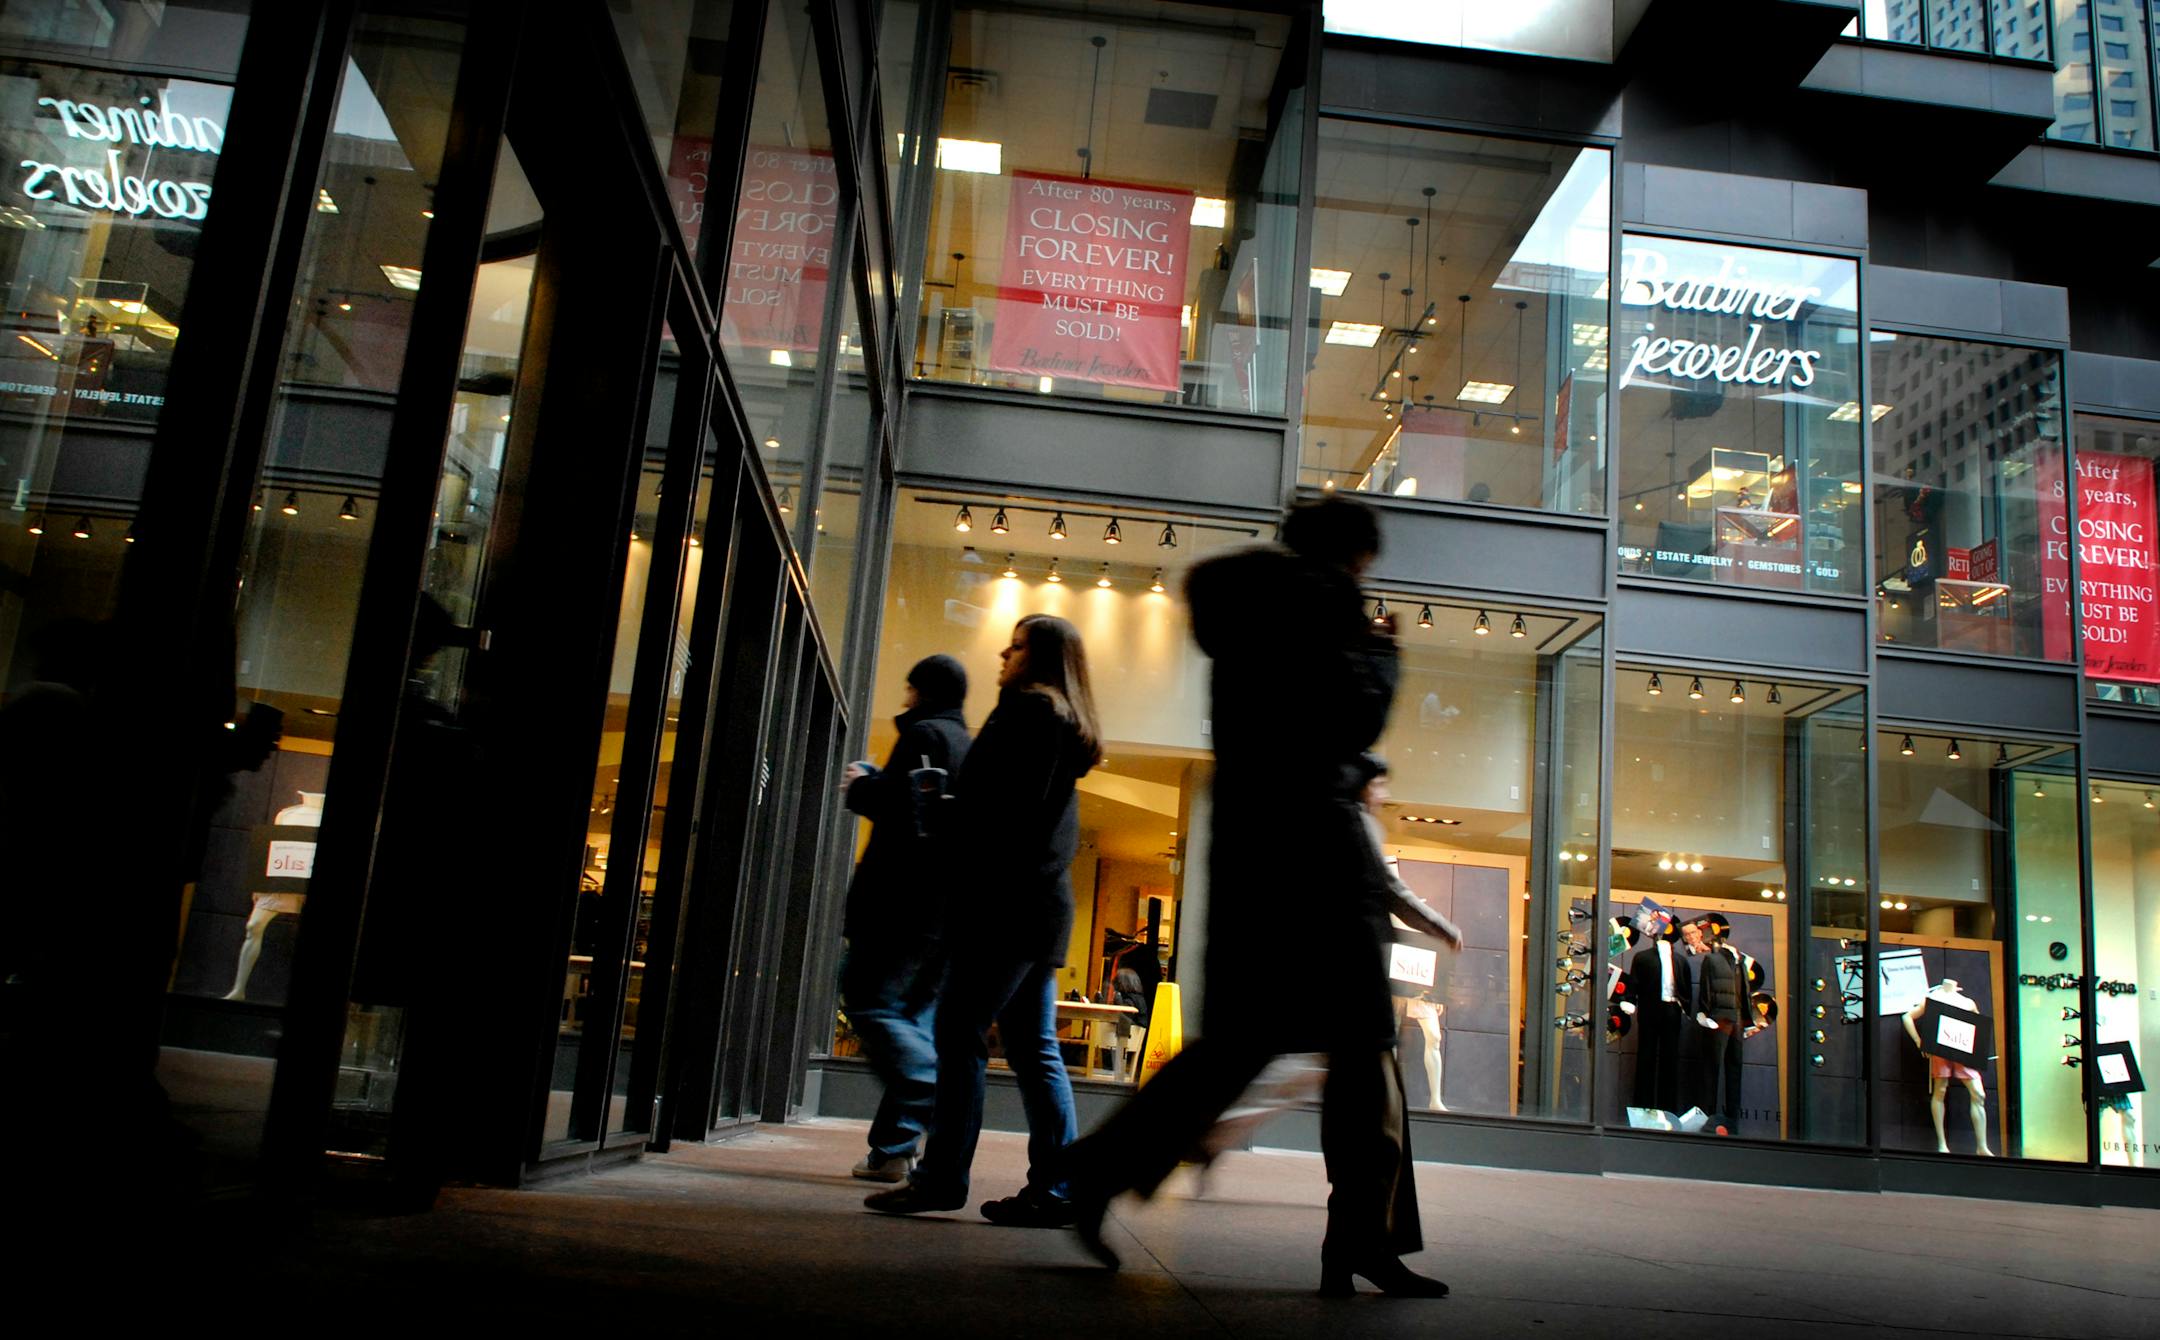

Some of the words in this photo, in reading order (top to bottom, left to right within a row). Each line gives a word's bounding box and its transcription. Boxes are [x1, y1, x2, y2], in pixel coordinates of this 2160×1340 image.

[1028, 179, 1083, 200] After
[1089, 187, 1115, 205] 80
[1121, 195, 1177, 215] years,
[1030, 207, 1169, 243] CLOSING
[1019, 235, 1175, 276] FOREVER!
[1022, 269, 1165, 302] EVERYTHING
[1620, 248, 1822, 321] Badiner
[1042, 293, 1108, 316] MUST
[1115, 302, 1140, 321] BE
[1055, 319, 1121, 342] SOLD!
[1619, 323, 1821, 390] jewelers
[2074, 458, 2120, 480] After
[2084, 489, 2137, 508] years,
[2051, 515, 2144, 543] COSING
[1656, 550, 1690, 563] ESTATE
[1691, 553, 1733, 568] JEWELRY
[1747, 559, 1801, 575] GEMSTONES
[1815, 566, 1840, 578] GOLD
[1948, 555, 1970, 573] RETI
[2045, 577, 2153, 603] EVRYTHING
[2118, 605, 2139, 623] BE
[2081, 624, 2128, 643] SOLD!
[1738, 1108, 1782, 1122] HITE
[2103, 1141, 2149, 1154] UBERT
